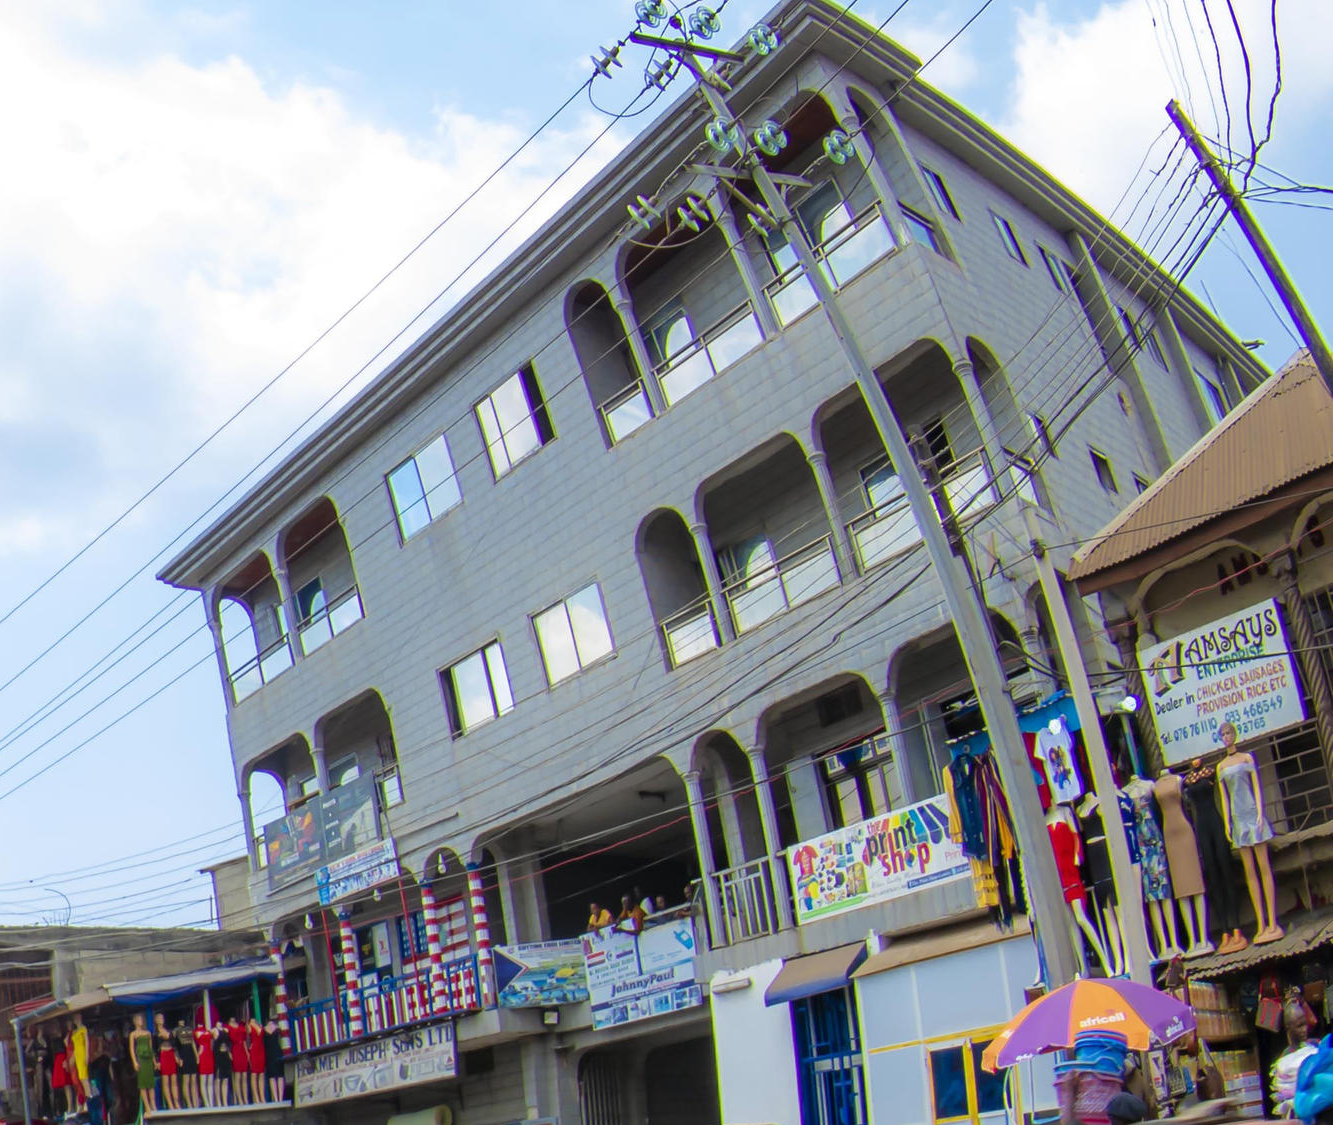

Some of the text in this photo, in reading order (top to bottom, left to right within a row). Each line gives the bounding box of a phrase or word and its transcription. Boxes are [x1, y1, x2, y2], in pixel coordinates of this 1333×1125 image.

[1155, 659, 1285, 716] Dealer in CHICKEN SAUSAGES
[1196, 692, 1245, 717] PROVISION
[1079, 1012, 1125, 1028] africell
[428, 1023, 452, 1047] LTD
